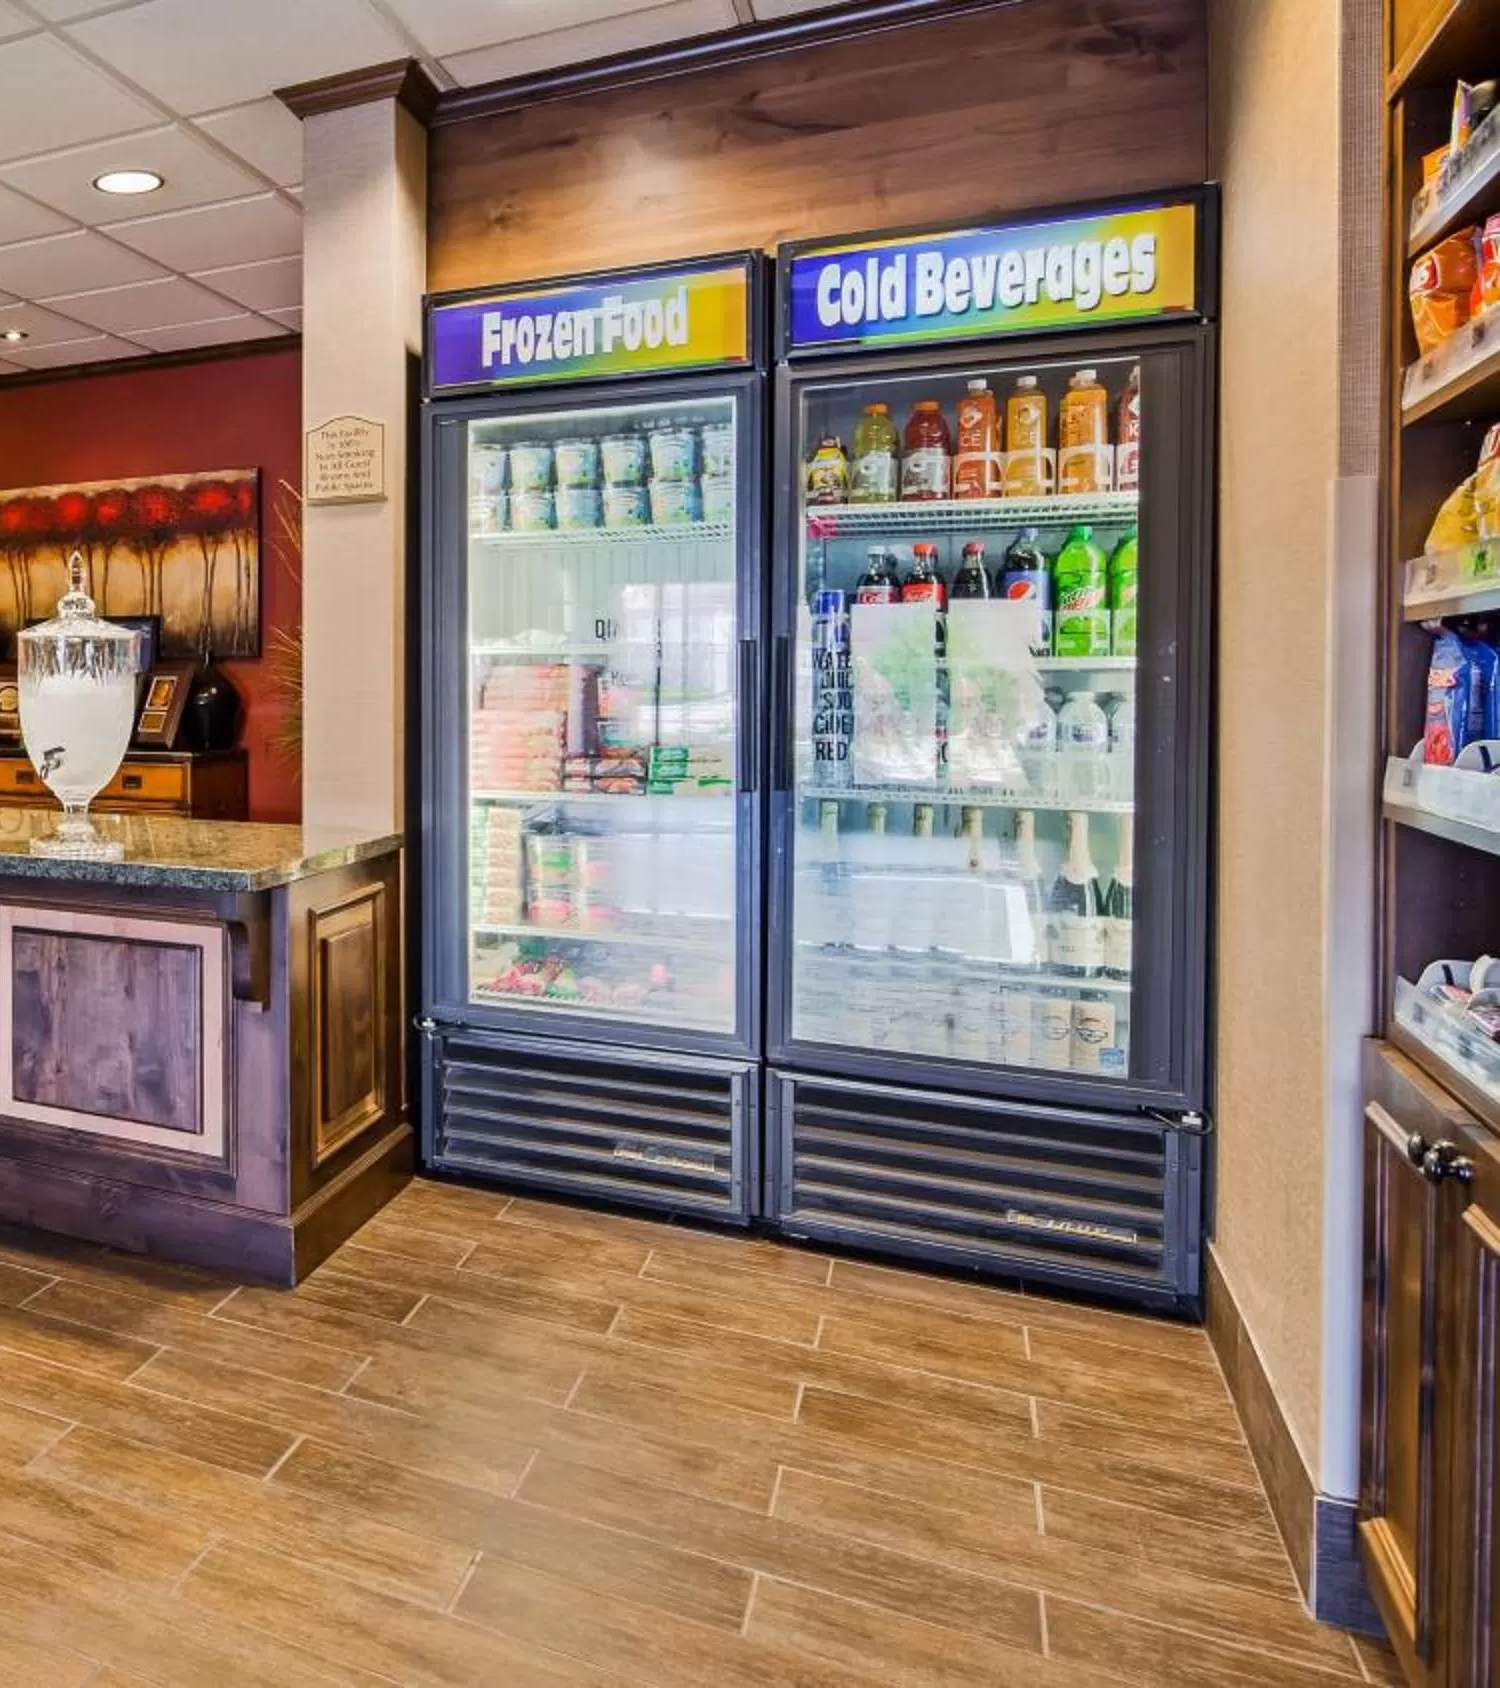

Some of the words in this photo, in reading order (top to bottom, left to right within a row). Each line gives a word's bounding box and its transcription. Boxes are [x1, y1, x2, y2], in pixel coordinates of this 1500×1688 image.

[817, 253, 908, 327] Cold
[915, 233, 1156, 315] Beverages
[481, 311, 596, 368] Frozen
[602, 285, 689, 353] Food
